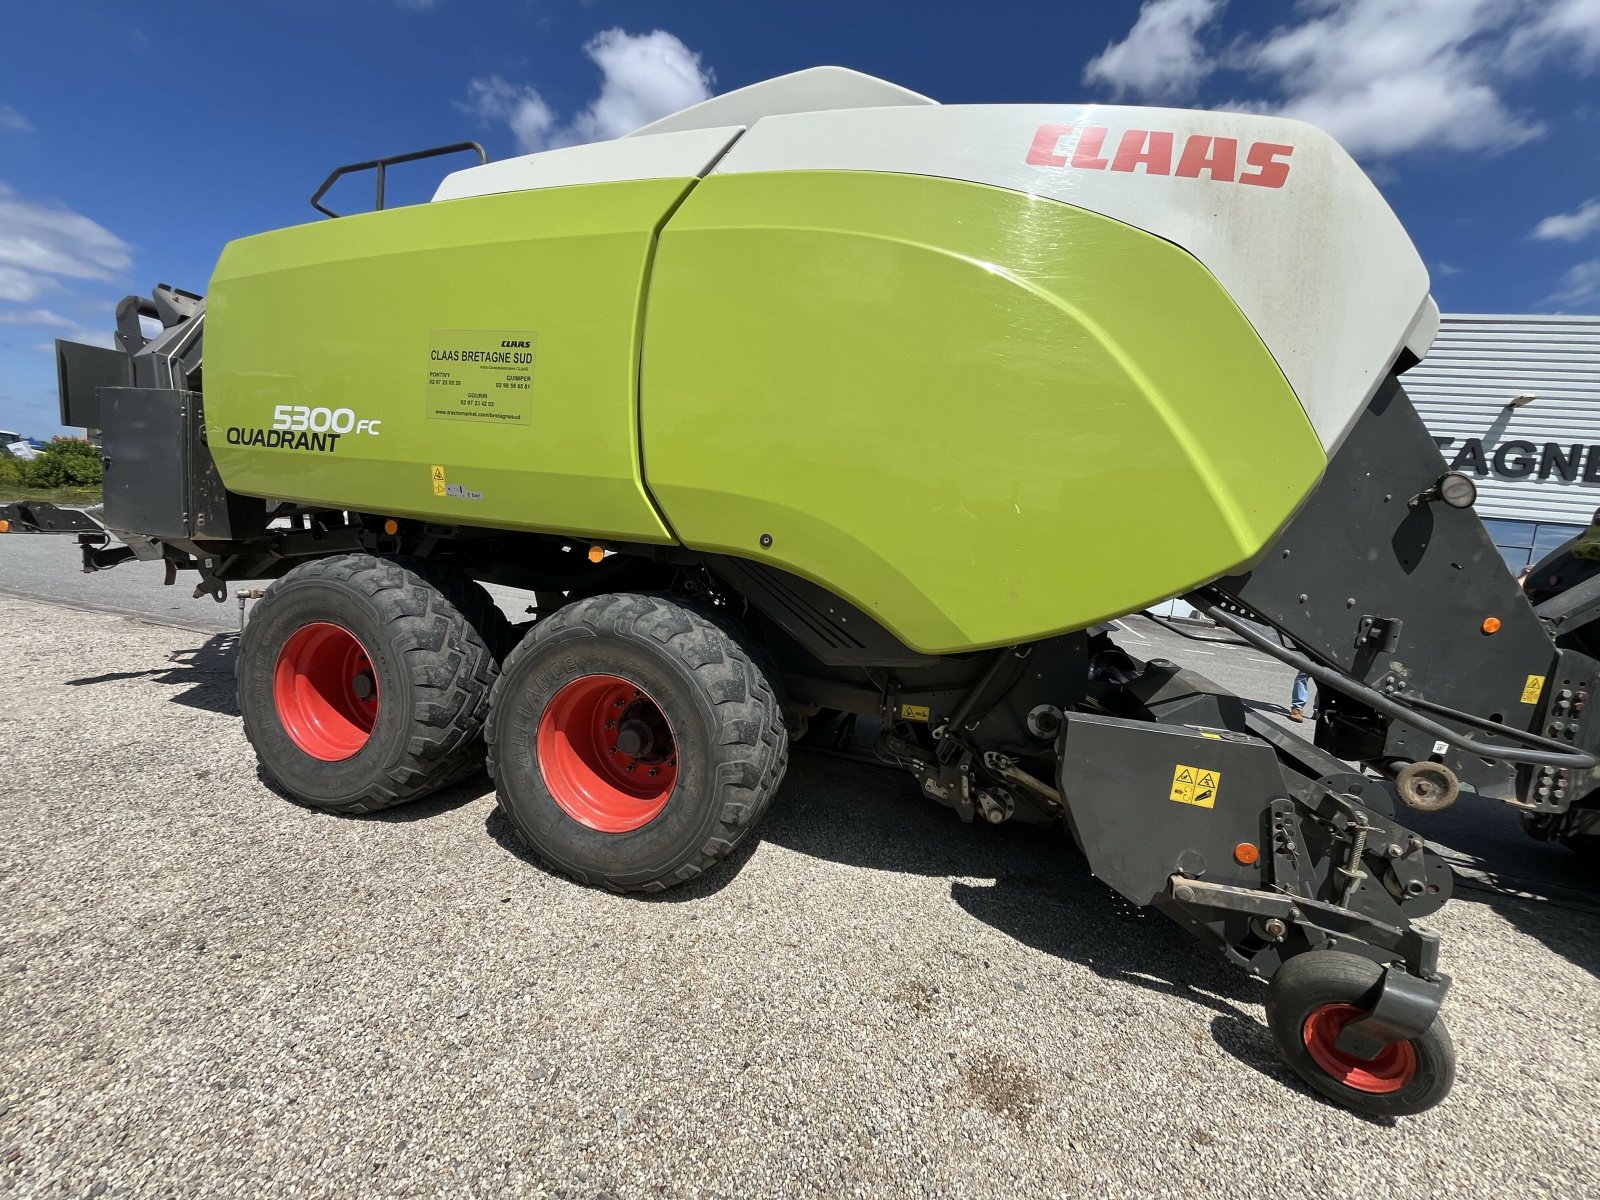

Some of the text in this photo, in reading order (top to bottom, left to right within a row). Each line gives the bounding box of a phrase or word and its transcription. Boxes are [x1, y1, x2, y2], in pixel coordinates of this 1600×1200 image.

[1025, 123, 1294, 189] CLAAS
[430, 349, 533, 364] CLAAS BRETAGNE SUD
[501, 340, 531, 348] CLAAS
[272, 404, 381, 436] 5300 FC
[226, 426, 341, 453] QUADRANT
